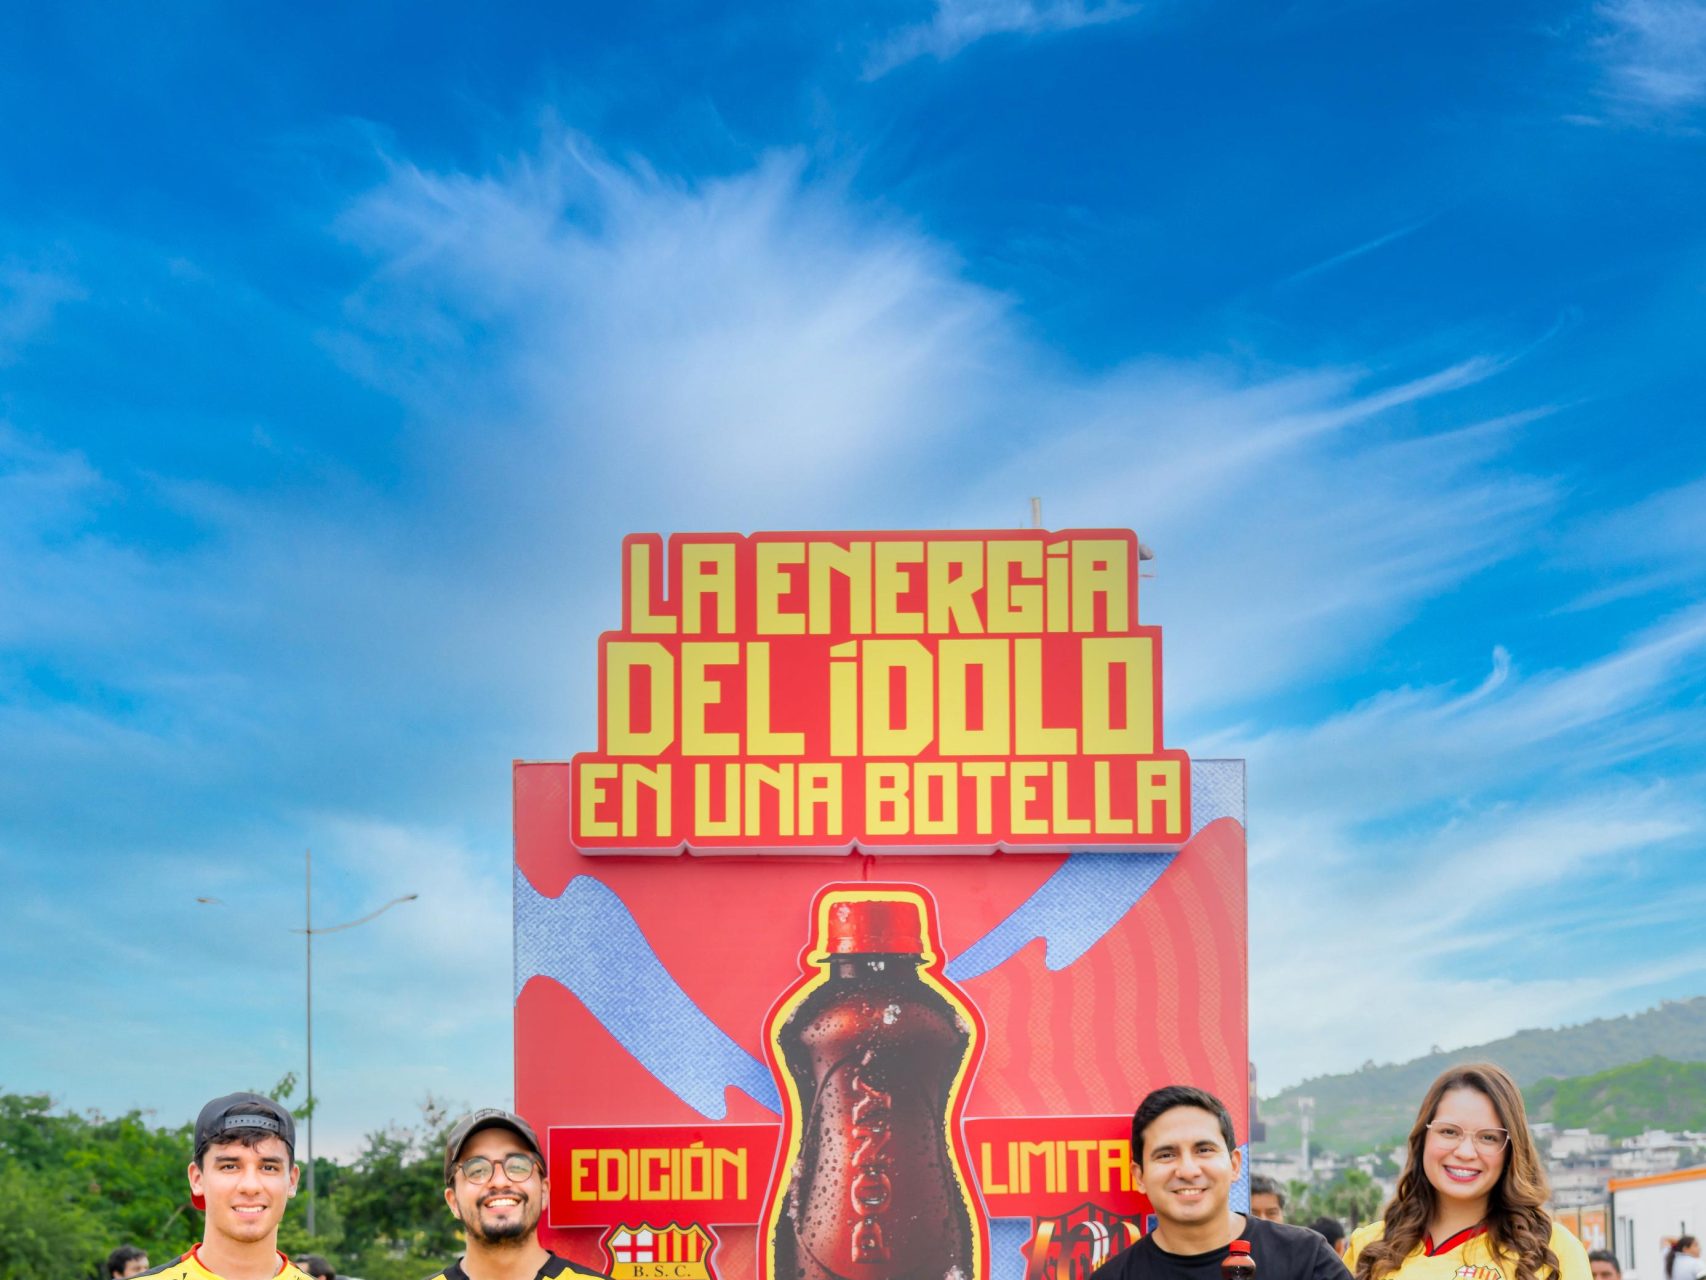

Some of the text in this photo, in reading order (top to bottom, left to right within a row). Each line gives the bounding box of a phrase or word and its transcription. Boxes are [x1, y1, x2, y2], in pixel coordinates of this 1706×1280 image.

[630, 539, 1129, 635] LA ENERGÍA
[606, 637, 1154, 757] DEL ÍDOLO
[579, 760, 1182, 838] EN UNA BOTELLA
[571, 1141, 748, 1201] EDICIÓN
[981, 1139, 1139, 1194] LIMITA
